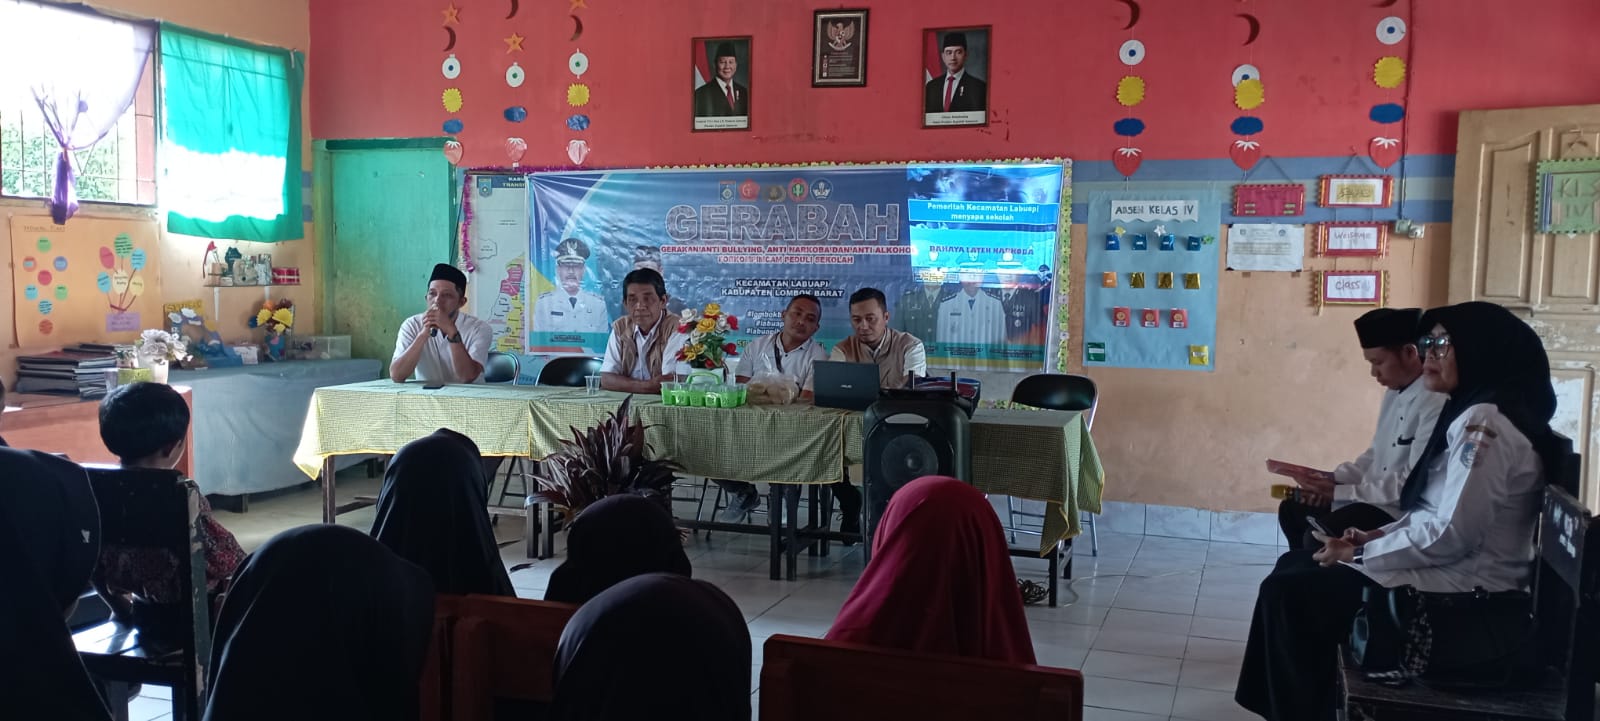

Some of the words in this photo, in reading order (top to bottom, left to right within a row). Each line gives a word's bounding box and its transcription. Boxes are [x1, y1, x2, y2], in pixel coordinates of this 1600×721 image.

[966, 203, 1008, 212] Kecamatan
[1009, 204, 1039, 213] Labuapi
[1115, 206, 1144, 215] ABSEN
[1148, 205, 1178, 215] KELAS
[1183, 205, 1194, 215] IV
[951, 213, 984, 221] menyapa
[986, 213, 1014, 221] sekolah
[665, 204, 900, 241] GERABAH
[721, 246, 765, 254] BULLYING,
[789, 246, 831, 254] NARKOBA
[832, 246, 850, 254] DAN
[852, 246, 873, 254] ANTI
[929, 245, 965, 253] BAHAYA
[993, 247, 1034, 255] NARKOBA
[784, 255, 812, 263] PEDULI
[814, 255, 853, 263] SEKOLAH
[735, 279, 789, 287] KECAMATAN
[791, 280, 828, 288] LABUAPI
[721, 288, 773, 296] KABUPATEN
[814, 289, 844, 297] BARAT
